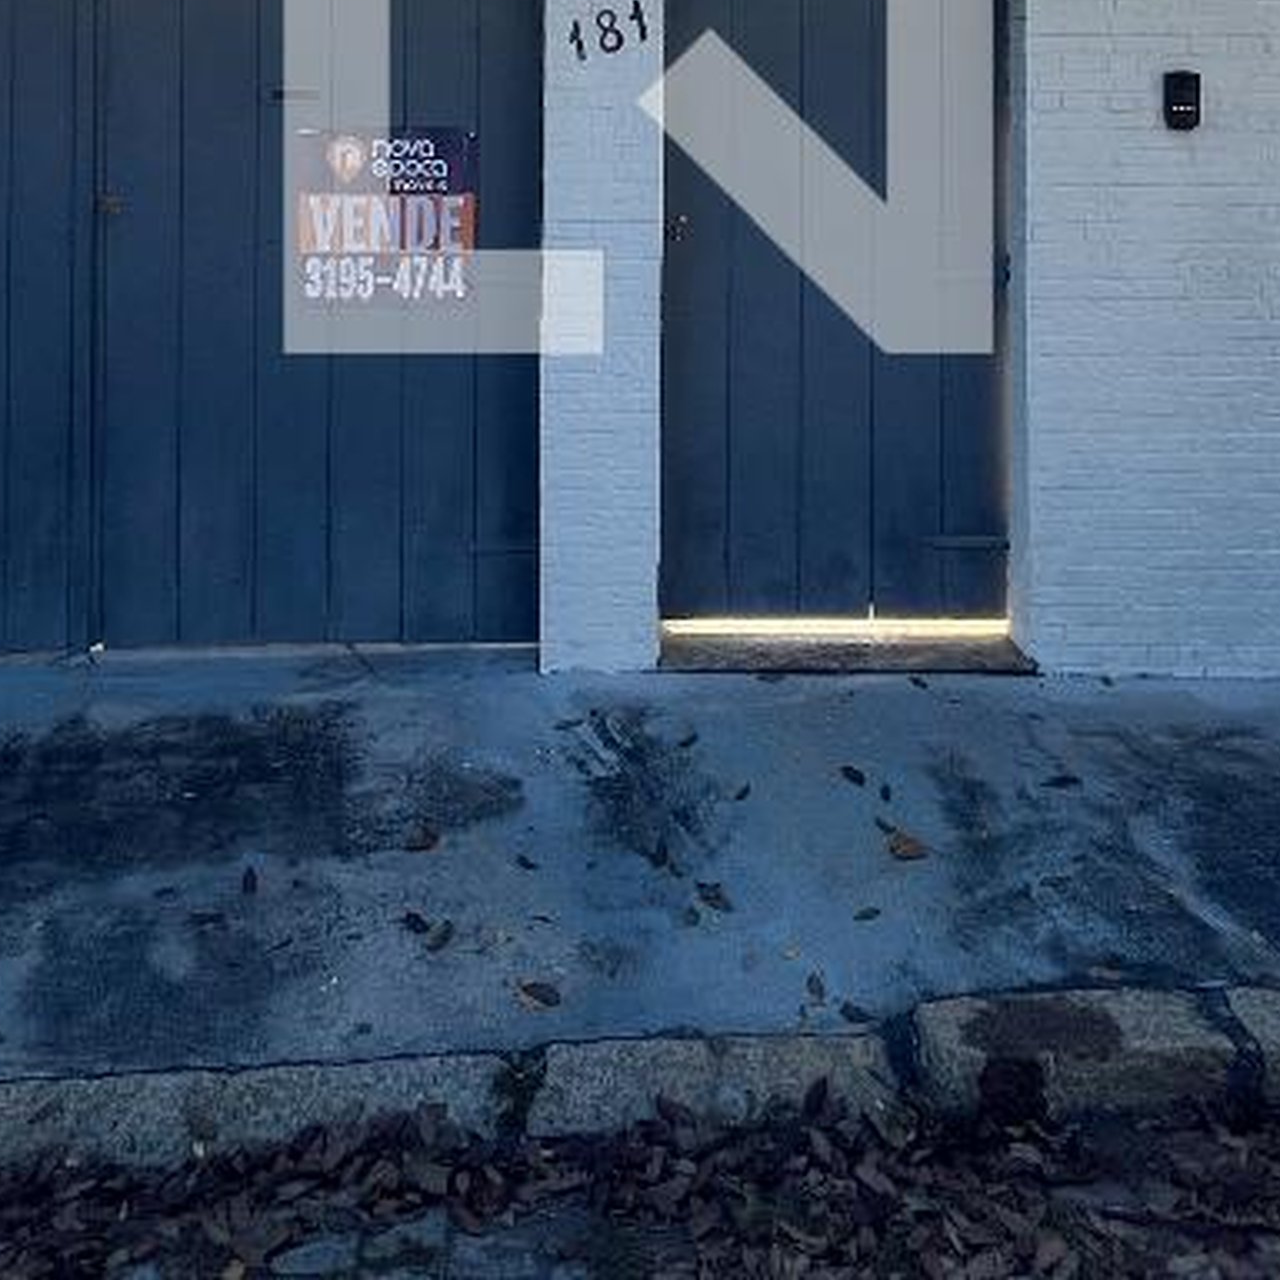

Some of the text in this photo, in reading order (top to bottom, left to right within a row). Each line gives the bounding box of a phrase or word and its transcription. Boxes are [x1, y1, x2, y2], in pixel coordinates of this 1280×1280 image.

[569, 0, 647, 61] 181
[372, 139, 435, 158] nova
[308, 193, 466, 254] VENDE
[304, 256, 467, 298] 3195-4744
